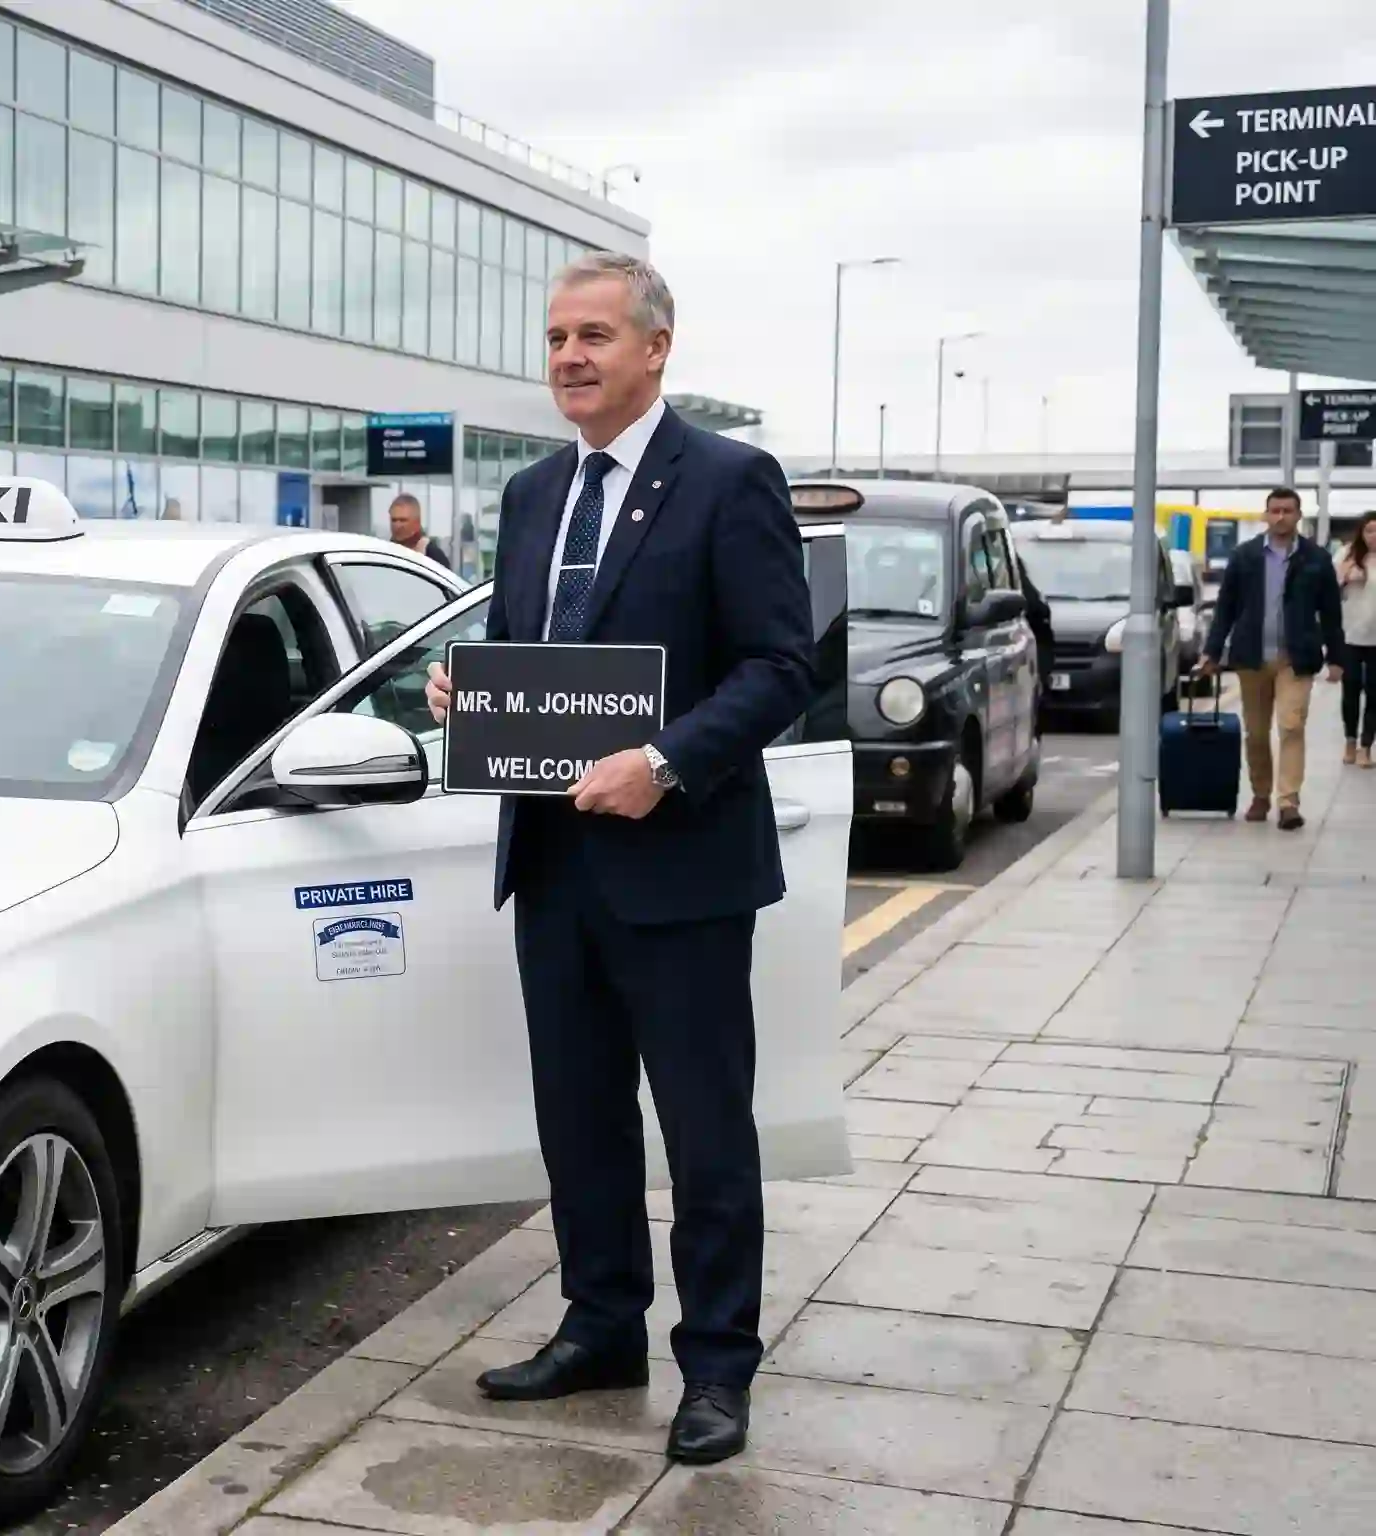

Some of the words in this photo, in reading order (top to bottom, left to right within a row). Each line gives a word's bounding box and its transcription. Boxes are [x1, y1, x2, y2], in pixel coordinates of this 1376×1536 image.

[1235, 102, 1376, 133] TERMINAL
[1235, 146, 1349, 175] PICK-UP
[1235, 179, 1322, 206] POINT
[456, 690, 498, 713] MR.
[505, 691, 530, 713] M.
[537, 692, 654, 716] JOHNSON
[487, 756, 594, 780] WELCOM
[299, 886, 366, 905] PRIVATE
[369, 883, 409, 899] HIRE
